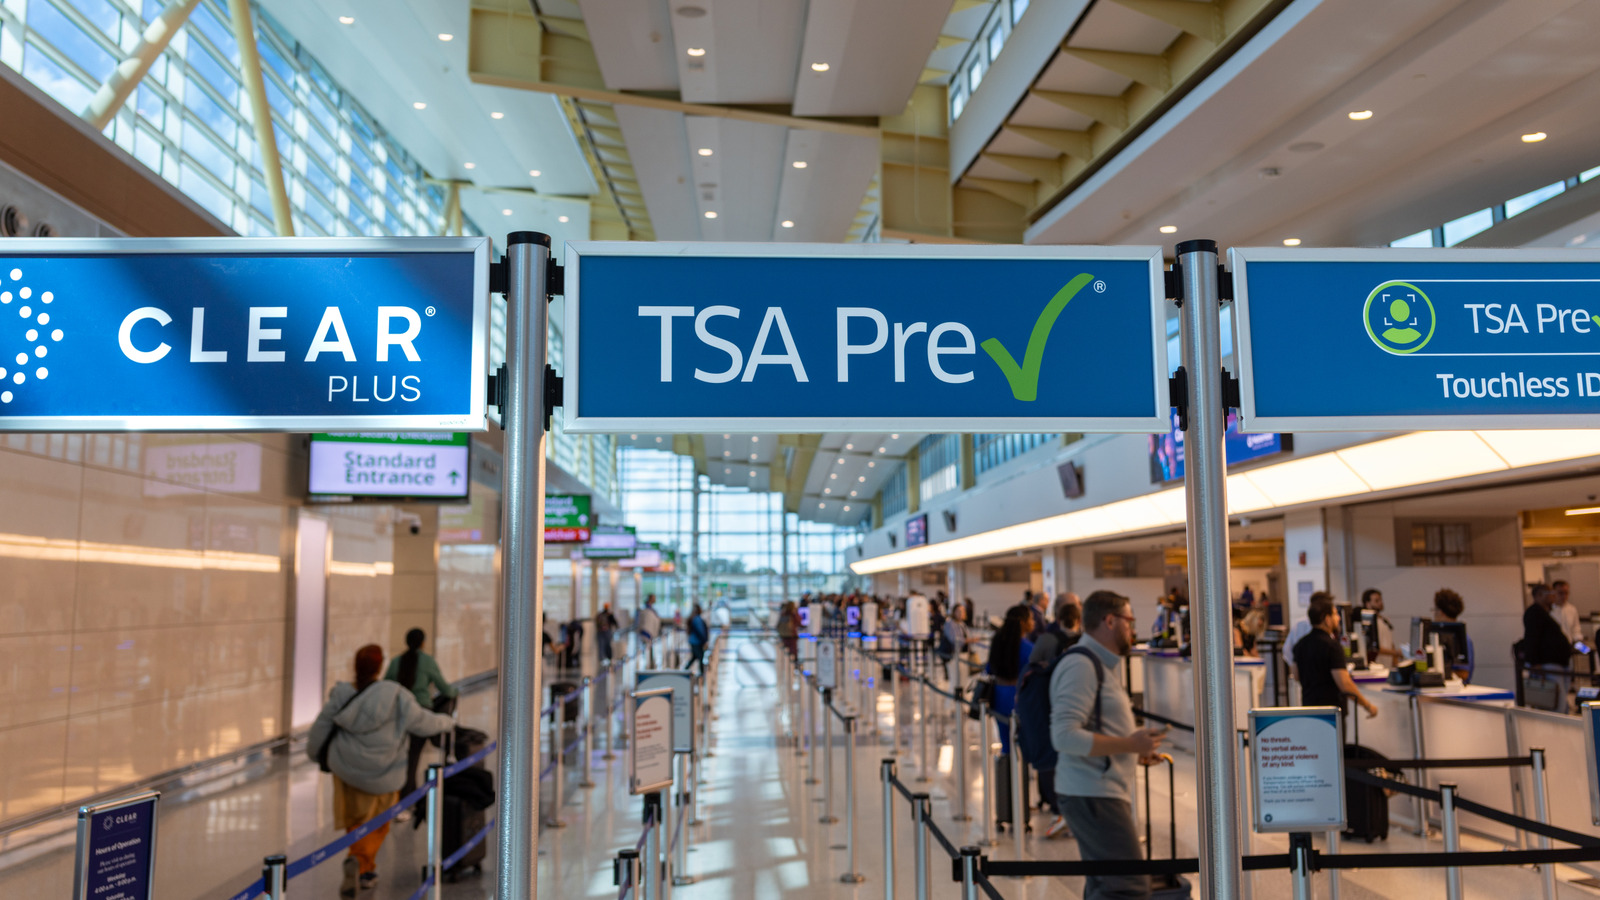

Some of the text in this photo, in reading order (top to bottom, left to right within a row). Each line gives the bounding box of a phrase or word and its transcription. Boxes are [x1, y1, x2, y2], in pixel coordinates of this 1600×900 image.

[1463, 303, 1591, 334] TSA Pre
[638, 304, 809, 384] TSA
[328, 375, 421, 402] PLUS
[1436, 371, 1600, 398] Touchless ID
[345, 451, 436, 469] Standard
[345, 467, 435, 485] Entrance
[1271, 754, 1294, 762] physical
[115, 812, 137, 824] CLEAR
[95, 847, 111, 855] Hours
[117, 837, 141, 849] Operation
